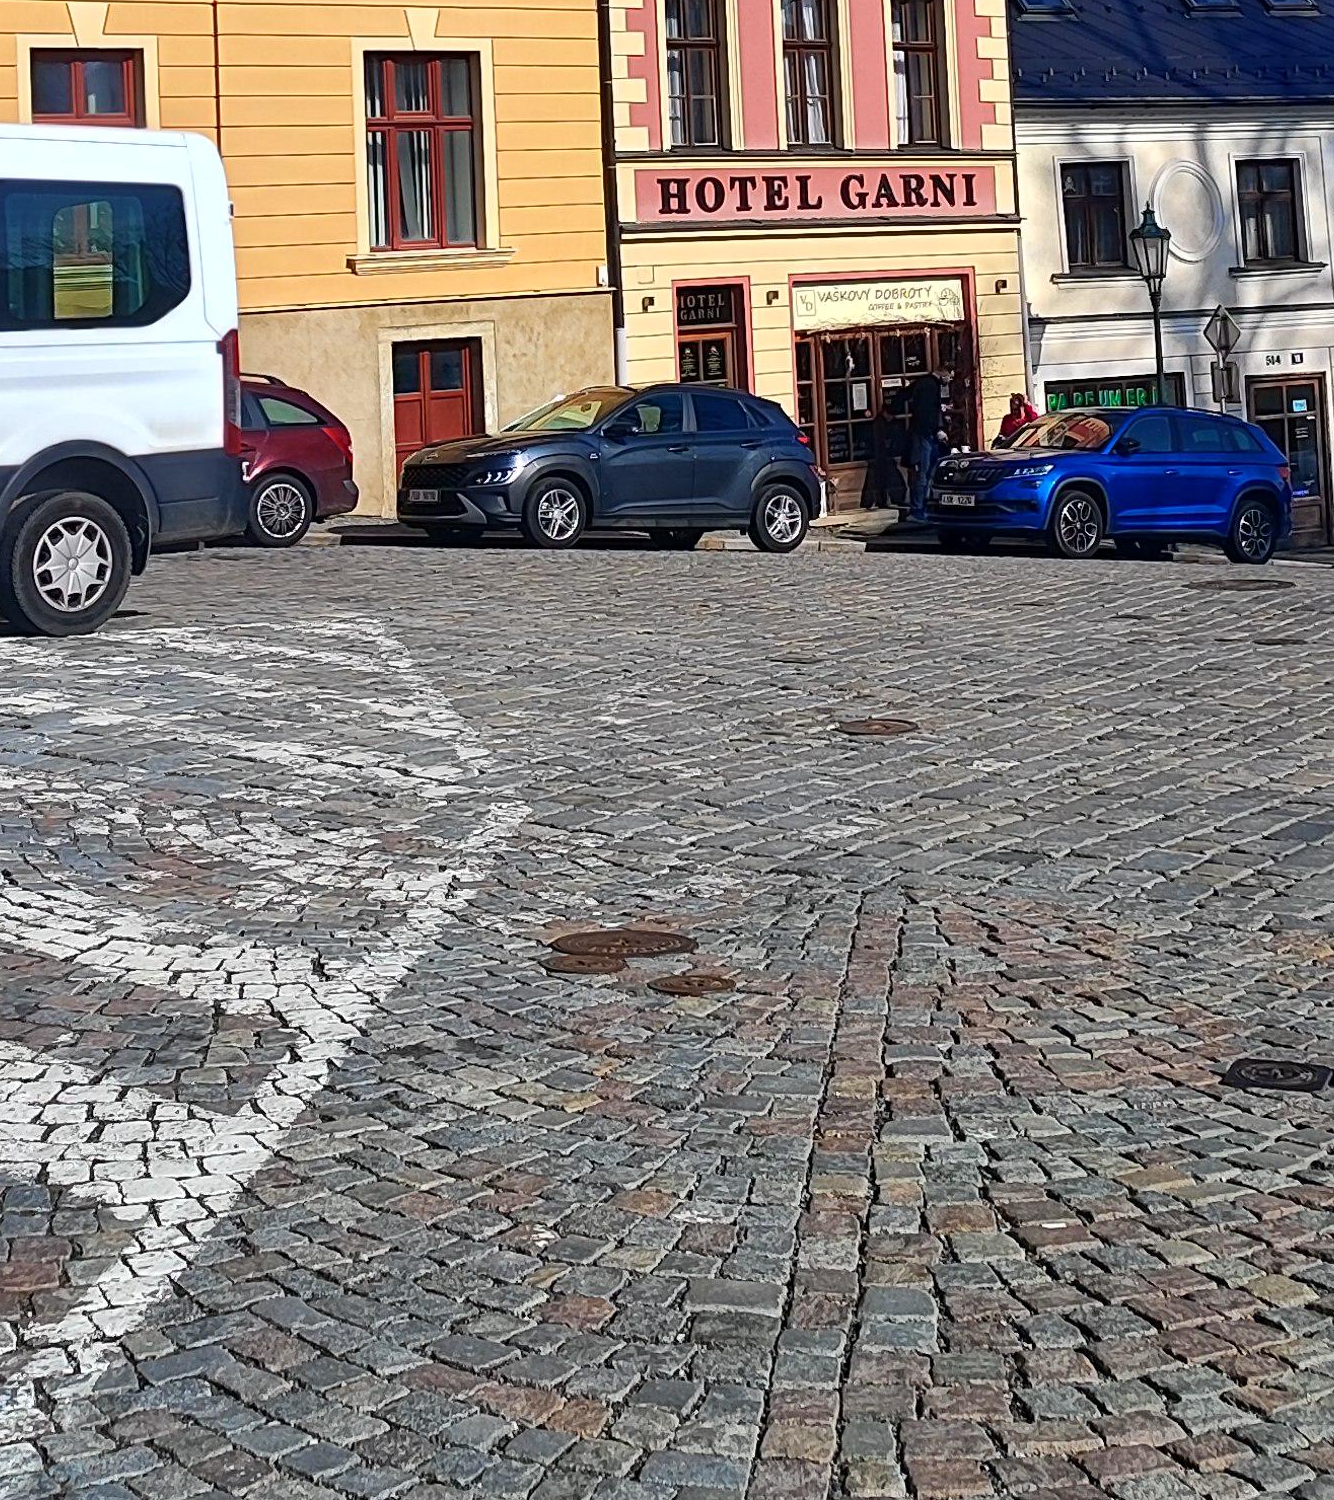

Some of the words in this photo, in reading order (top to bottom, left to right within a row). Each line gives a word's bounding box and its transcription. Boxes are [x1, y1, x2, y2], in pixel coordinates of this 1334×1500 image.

[657, 175, 822, 214] HOTEL
[840, 173, 977, 210] GARNI
[875, 286, 932, 300] DOBROTY
[868, 303, 895, 311] COFFEE
[905, 301, 932, 310] PASTRY
[680, 307, 720, 320] GARNI
